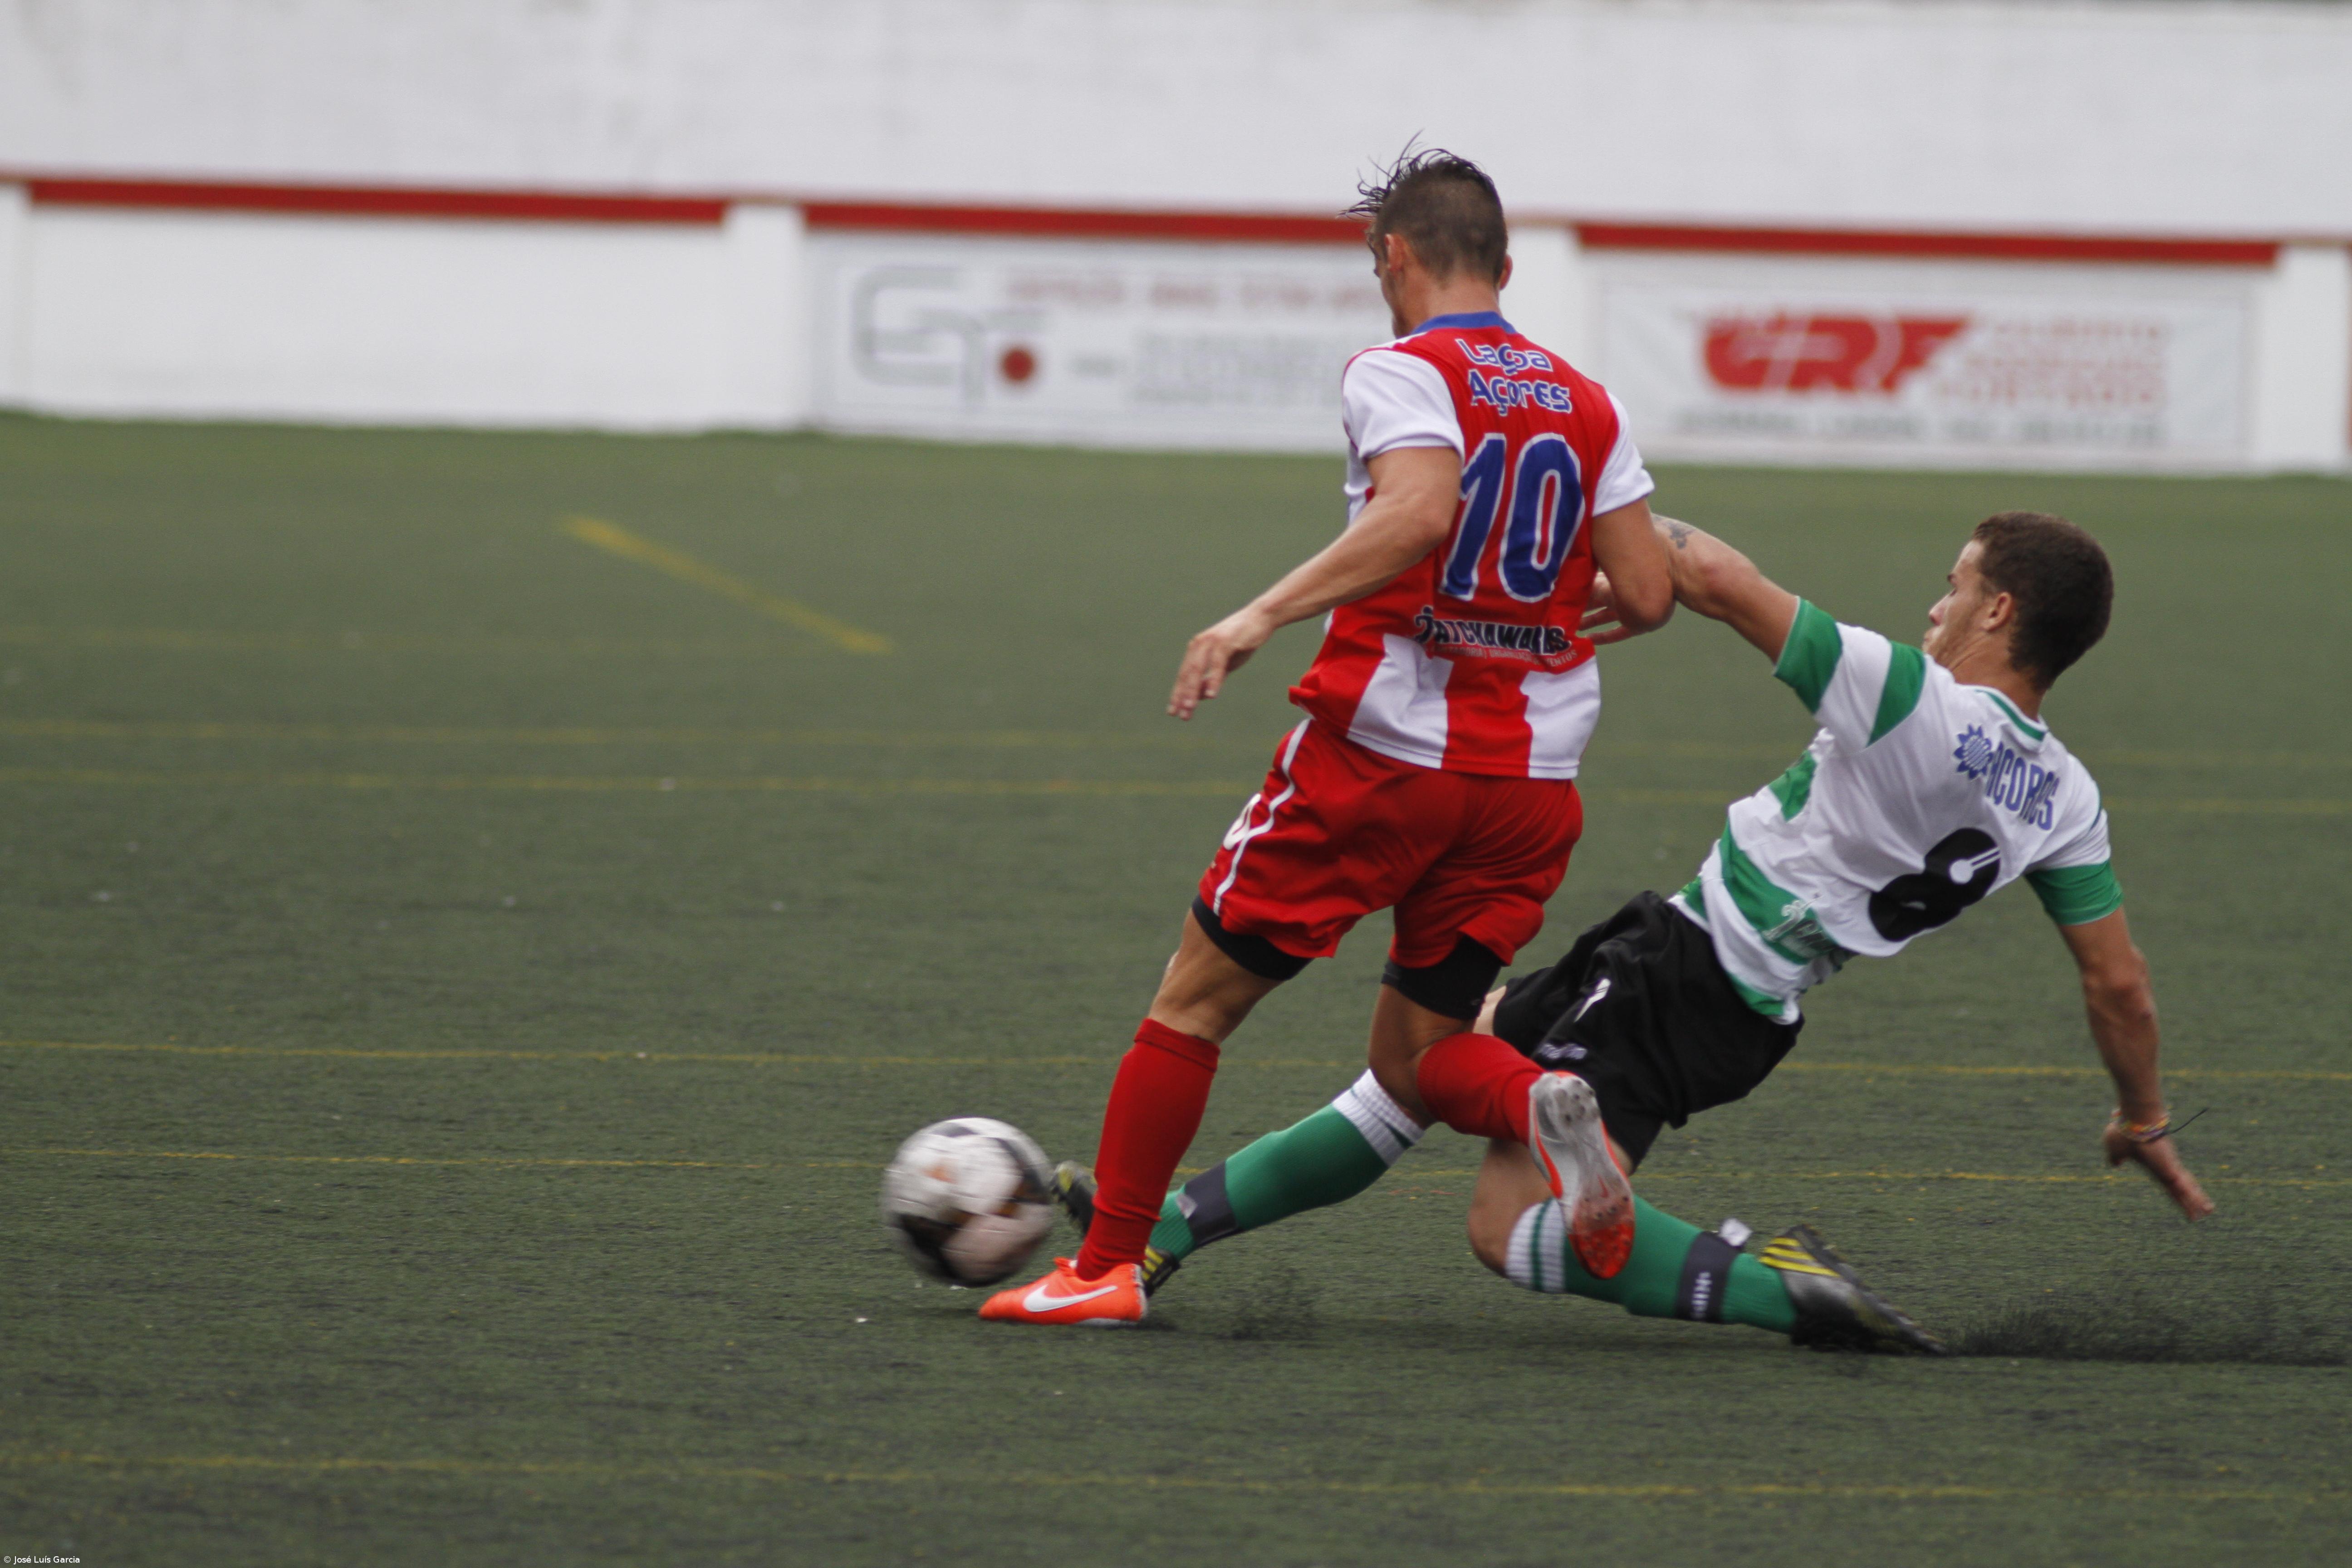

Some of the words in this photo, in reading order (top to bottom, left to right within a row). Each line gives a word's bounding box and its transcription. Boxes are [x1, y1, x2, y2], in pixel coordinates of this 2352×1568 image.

[1467, 368, 1573, 416] Açores
[1439, 433, 1585, 603] 10
[1869, 828, 2000, 942] 8
